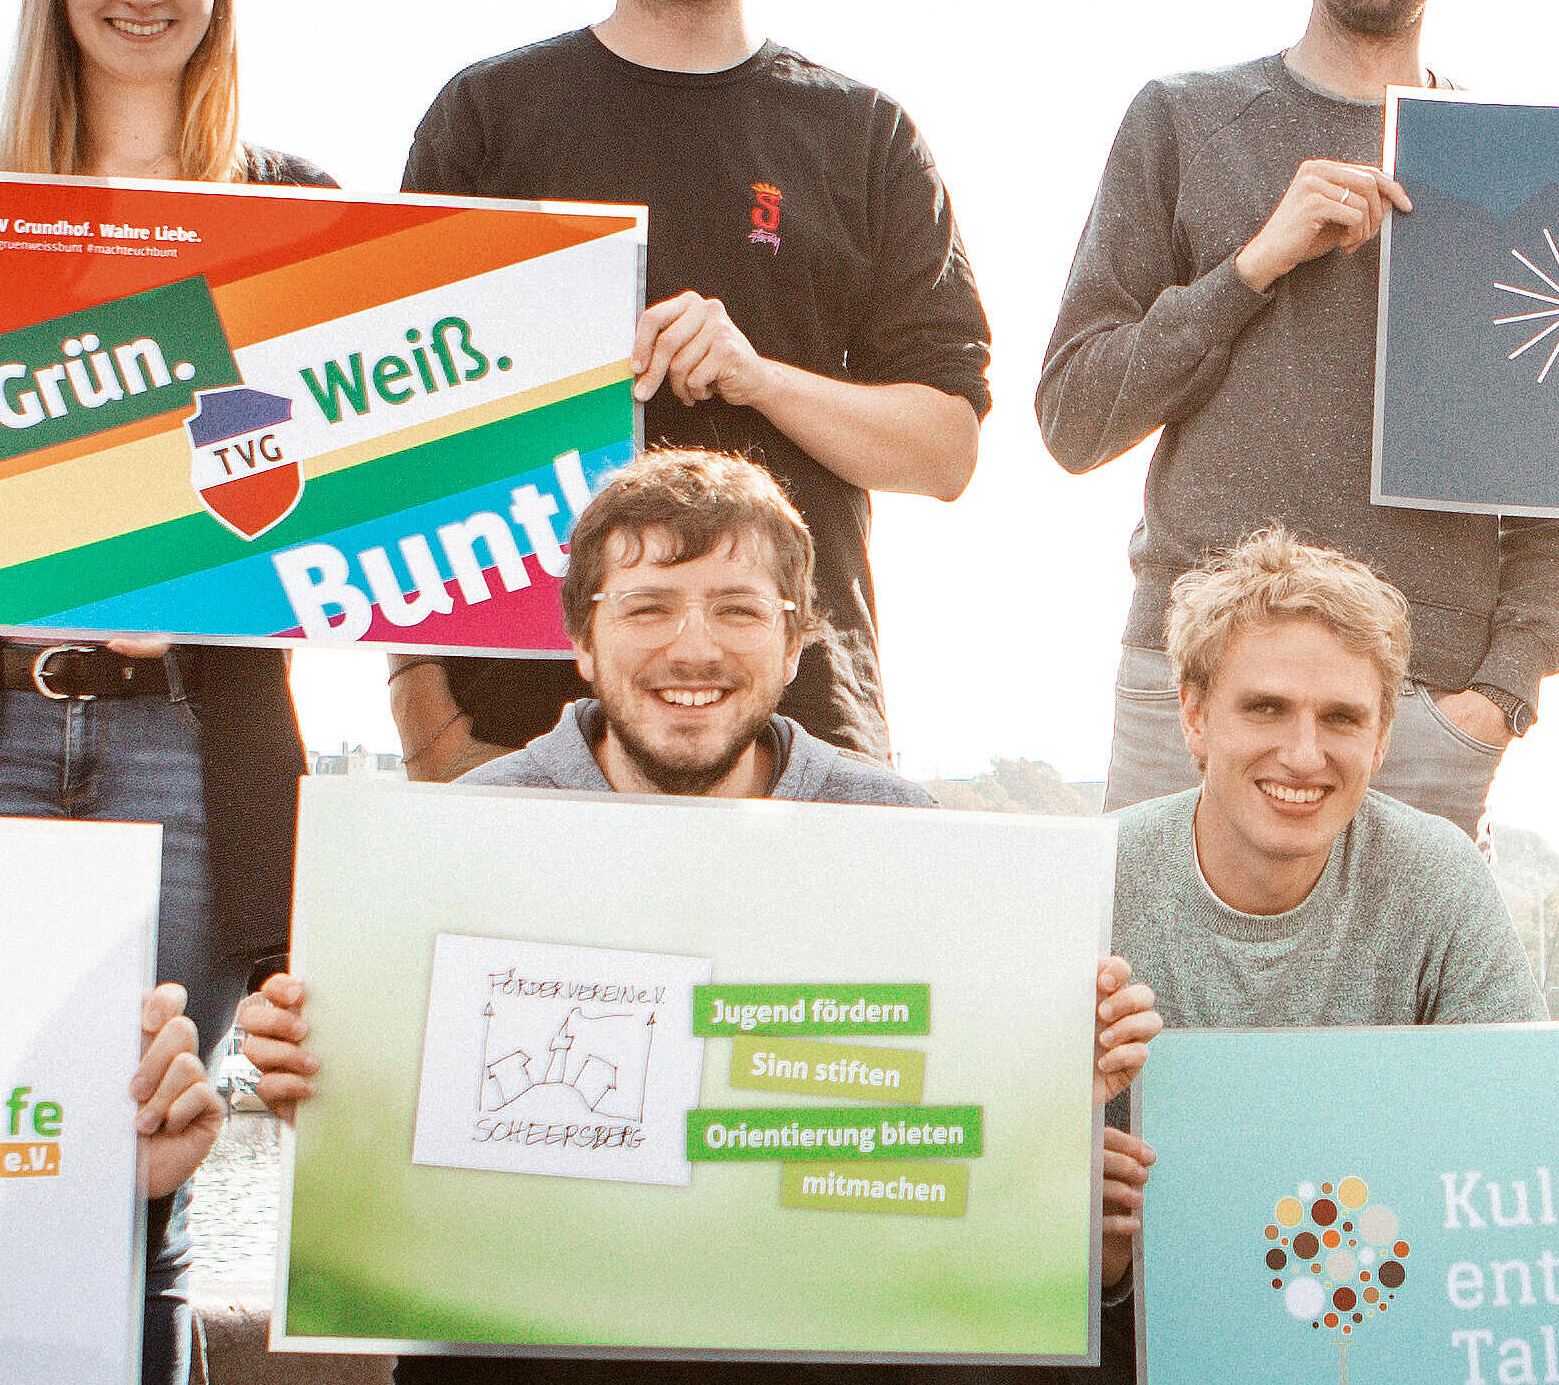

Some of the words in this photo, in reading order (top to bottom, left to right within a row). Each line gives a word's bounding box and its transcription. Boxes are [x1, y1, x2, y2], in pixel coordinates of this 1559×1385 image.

[13, 219, 94, 237] Grundhof.
[100, 223, 150, 240] Wahre
[155, 225, 202, 242] Liebe.
[87, 243, 178, 257] #machteuchbunt
[299, 316, 514, 424] Weiß.
[212, 434, 283, 477] TVG
[489, 968, 634, 1004] FÖRDERVEREIN
[712, 998, 805, 1031] Jugend
[811, 997, 910, 1025] fördern
[751, 1051, 808, 1081] Sinn
[814, 1055, 901, 1089] stiften
[473, 1119, 646, 1149] SCHEERSBERG
[706, 1122, 876, 1151] Orientierung
[883, 1120, 964, 1148] bieten
[4, 1146, 54, 1172] e.V.
[802, 1171, 947, 1203] mitmachen
